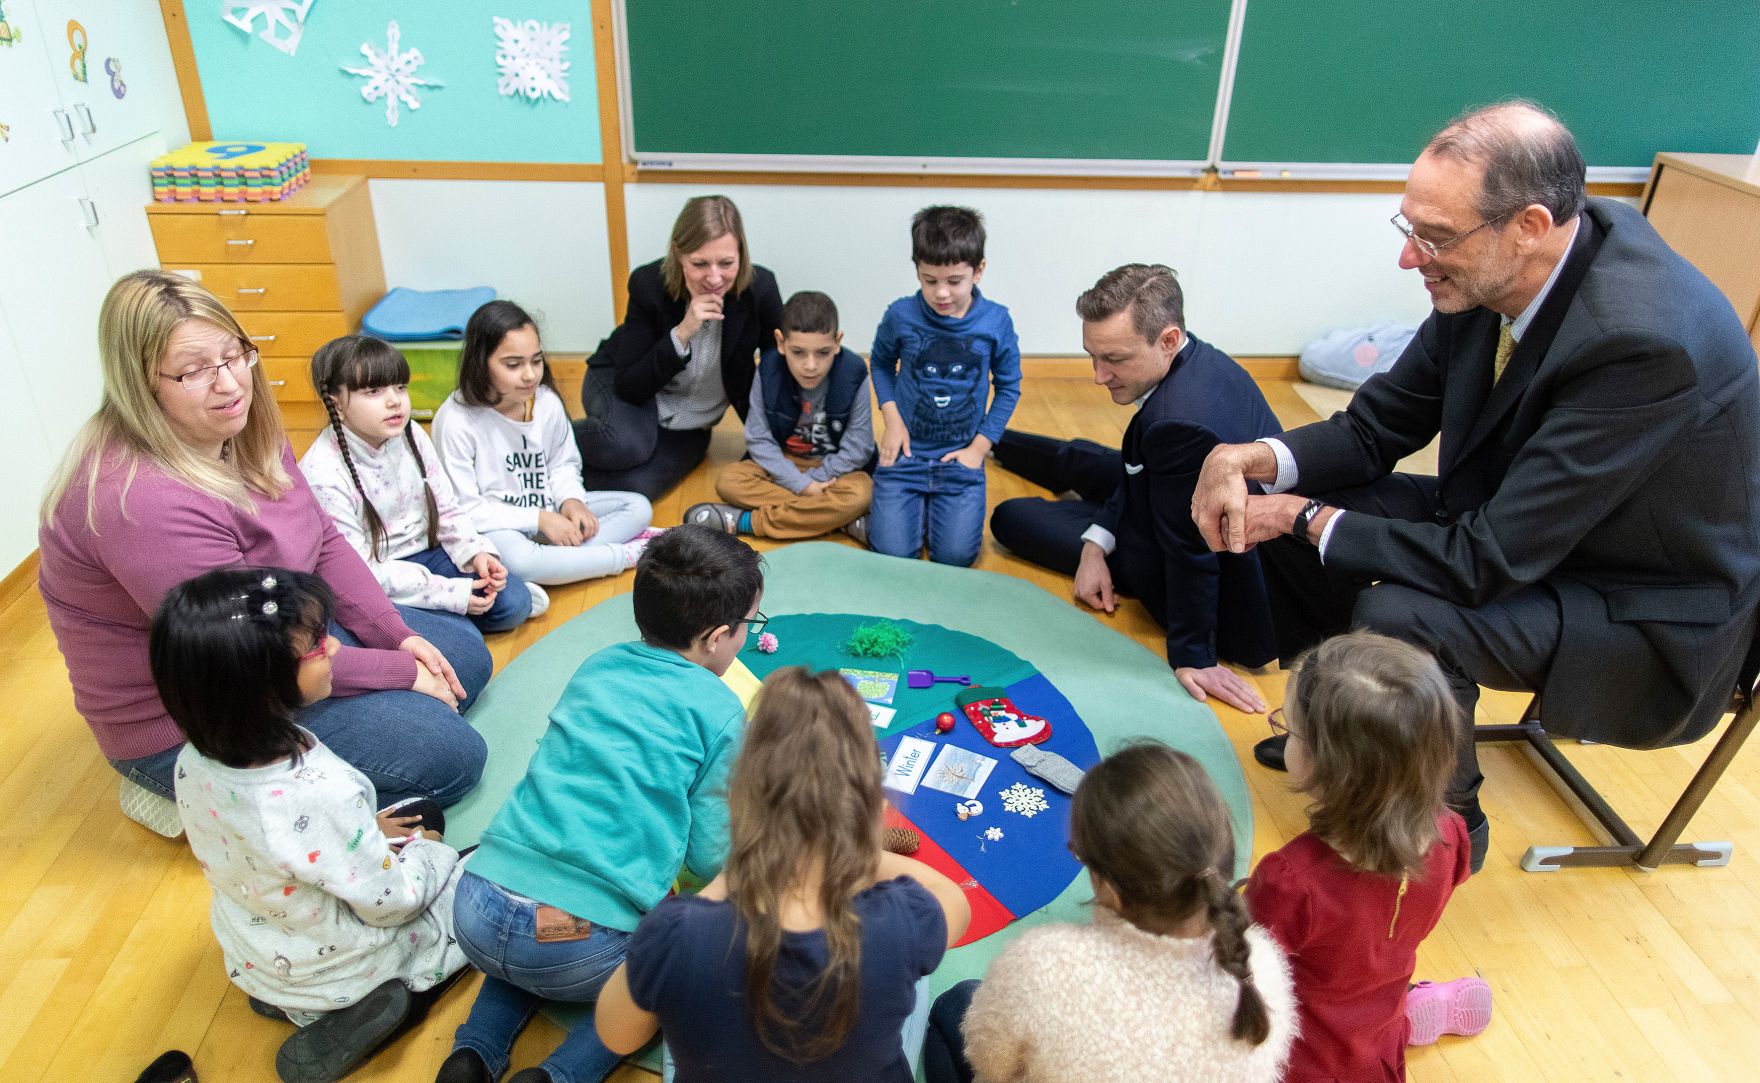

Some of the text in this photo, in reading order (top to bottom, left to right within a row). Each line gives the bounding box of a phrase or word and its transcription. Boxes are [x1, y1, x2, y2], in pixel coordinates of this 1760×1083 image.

[521, 433, 527, 450] I
[505, 452, 545, 472] SAVE
[894, 749, 921, 777] Winter
